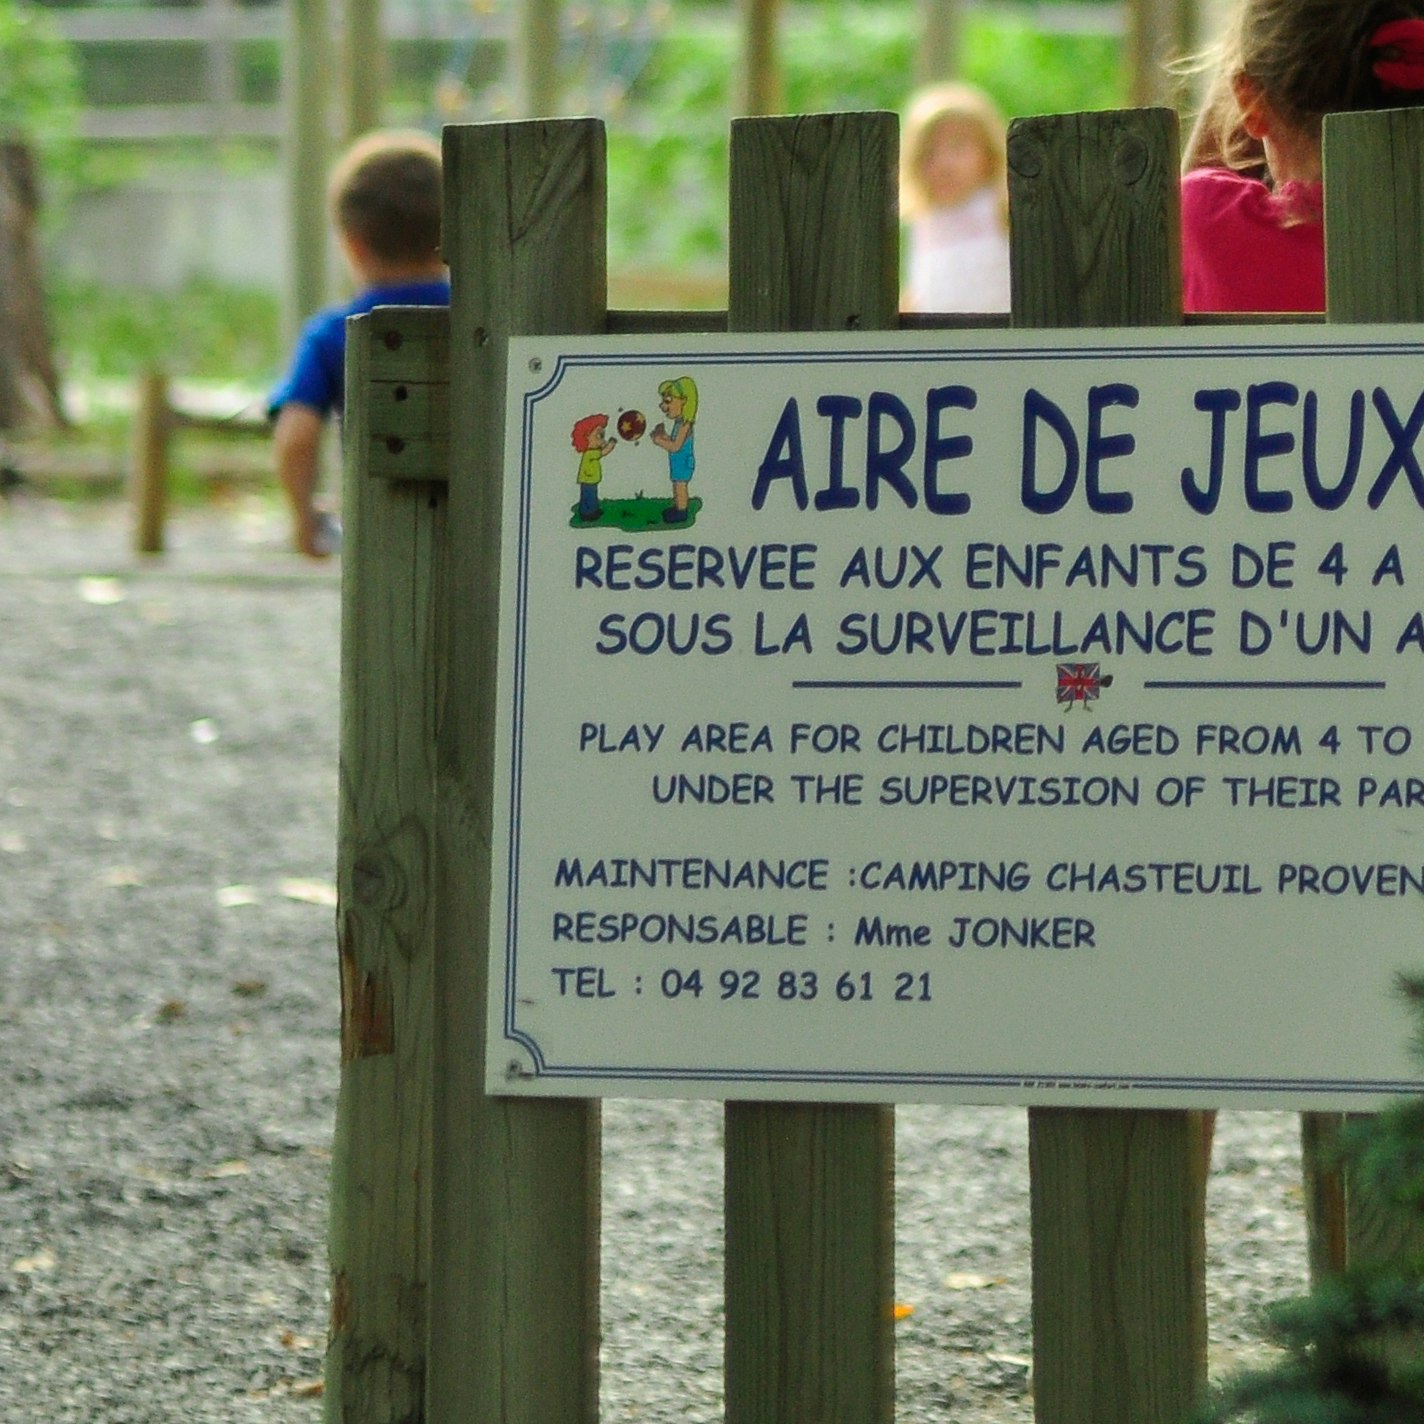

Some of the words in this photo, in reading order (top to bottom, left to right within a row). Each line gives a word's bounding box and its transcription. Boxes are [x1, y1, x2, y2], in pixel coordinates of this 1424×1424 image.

[751, 384, 977, 515] AIRE
[1021, 382, 1141, 515] DE
[575, 544, 818, 590] RESERVEE
[839, 544, 944, 590] AUX
[965, 543, 1208, 590] ENFANTS
[1231, 541, 1296, 589] DE
[1317, 541, 1349, 587] 4
[1371, 543, 1405, 587] A
[595, 611, 733, 656] SOUS
[754, 611, 813, 656] LA
[836, 608, 1216, 657] SURVEILLANCE
[1239, 608, 1372, 657] D'UN
[579, 722, 665, 754] PLAY
[680, 722, 774, 754] AREA
[790, 722, 862, 754] FOR
[877, 723, 1065, 755] CHILDREN
[1081, 723, 1180, 755] AGED
[1196, 723, 1302, 756] FROM
[1318, 723, 1342, 755] 4
[1356, 724, 1412, 757] TO
[652, 773, 775, 805] UNDER
[790, 773, 864, 806] THE
[879, 774, 1140, 807] SUPERVISION
[1155, 775, 1206, 808] OF
[1222, 775, 1342, 809] THEIR
[554, 857, 830, 891] MAINTENANCE
[1046, 861, 1262, 896] CHASTEUIL
[552, 911, 809, 947] RESPONSABLE
[853, 915, 932, 948] Mme
[948, 916, 1097, 950] JONKER
[550, 967, 616, 999] TEL
[660, 968, 704, 1000] 04
[719, 969, 761, 1001] 92
[777, 970, 818, 1002] 83
[835, 971, 873, 1002] 61
[894, 971, 932, 1003] 21
